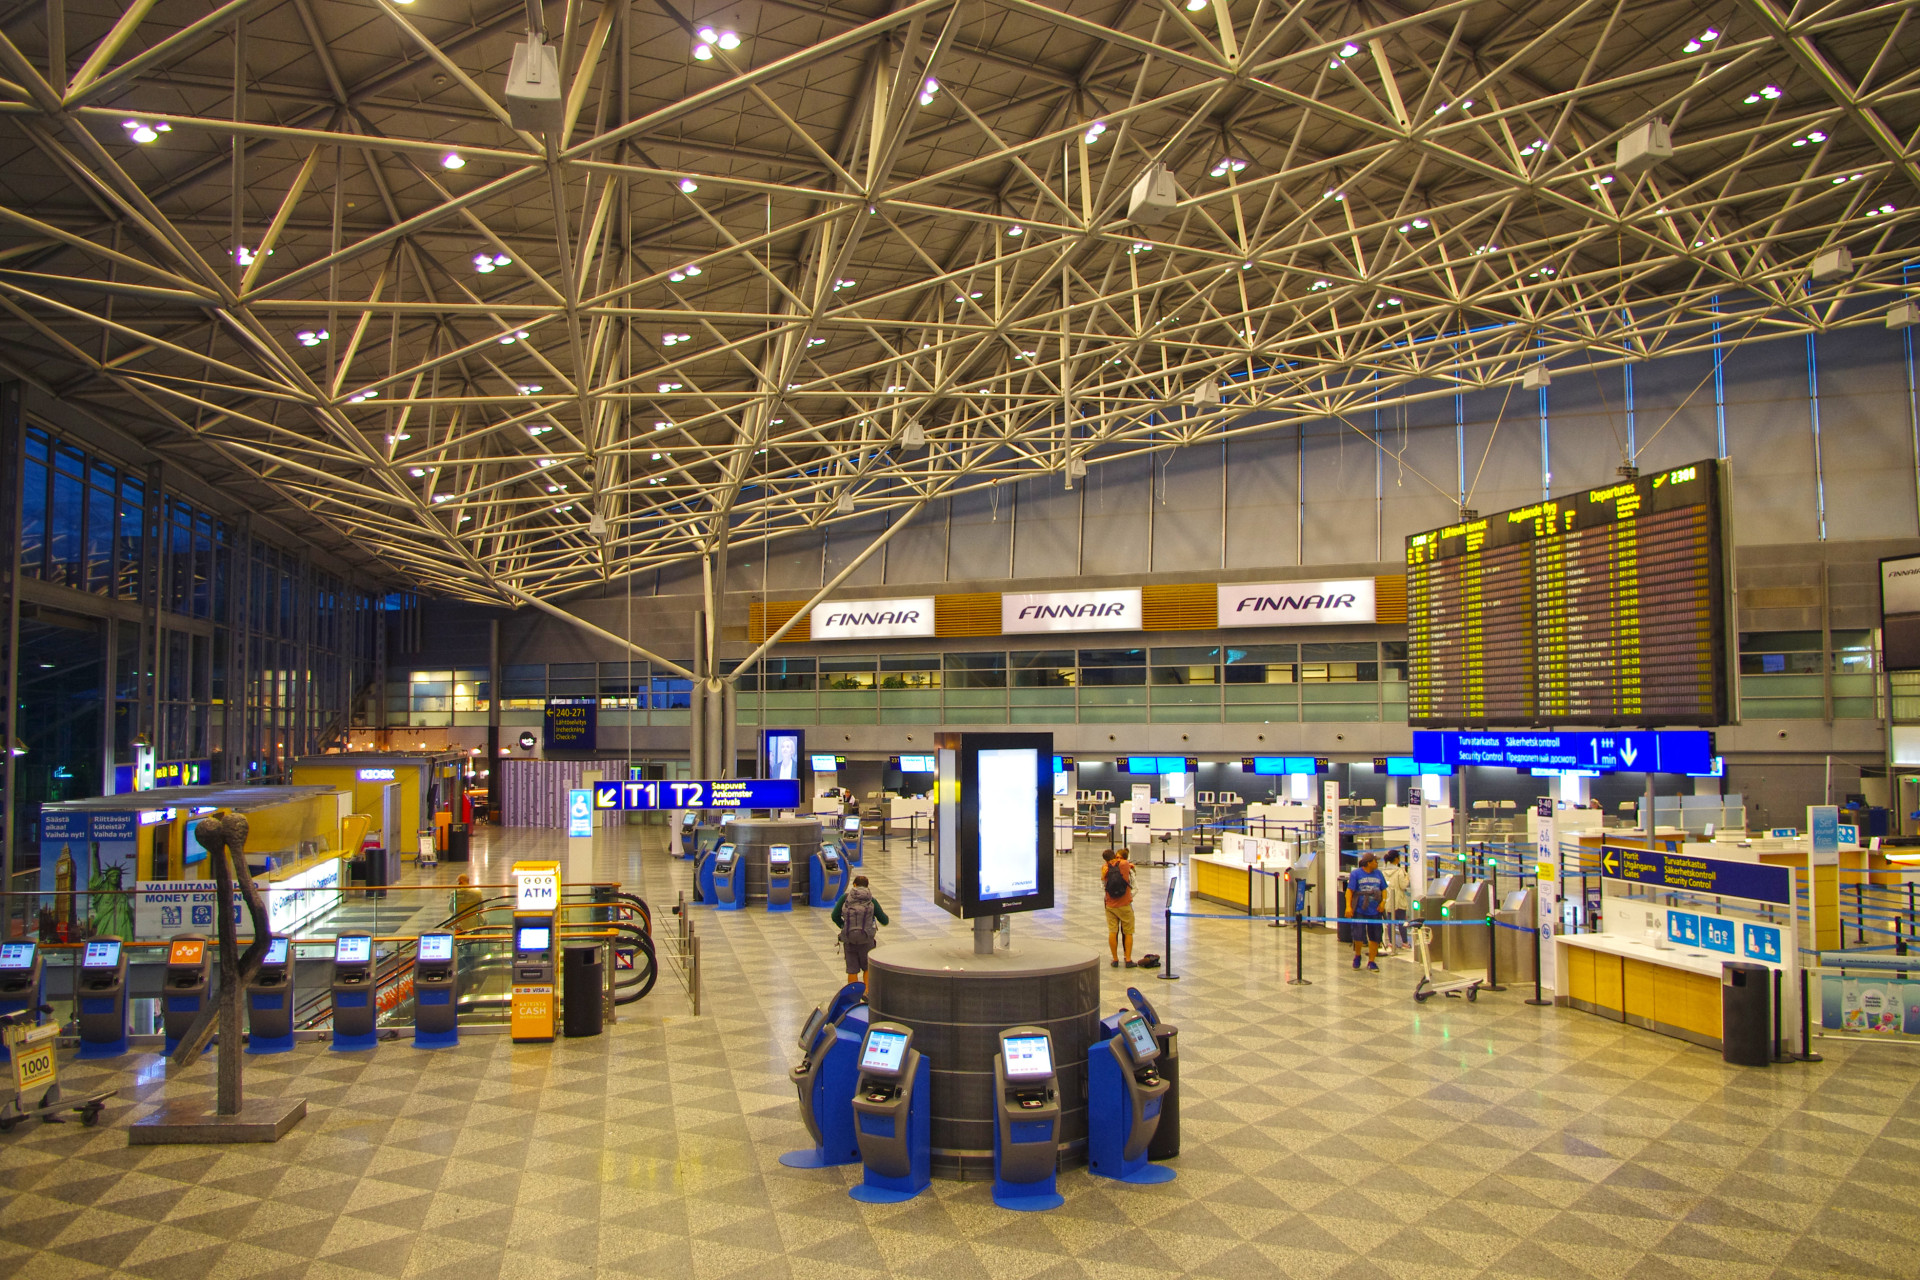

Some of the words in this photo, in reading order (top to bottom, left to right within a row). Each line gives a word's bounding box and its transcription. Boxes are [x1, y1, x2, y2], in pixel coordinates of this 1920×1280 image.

[1590, 484, 1635, 503] Departures
[1236, 594, 1356, 613] FINNAIR
[1019, 602, 1125, 620] FINNAIR
[826, 610, 920, 627] FINNAIR
[556, 708, 585, 718] 240-271
[1459, 736, 1500, 746] Turvatarkastus
[1506, 736, 1560, 748] Säkerhetskontroll
[1459, 751, 1481, 760] Security
[1482, 752, 1504, 761] Control
[1590, 738, 1598, 764] 1
[1602, 755, 1616, 765] min
[360, 768, 395, 780] KIOSK
[712, 782, 746, 790] Saapuvat
[626, 784, 656, 806] T1
[671, 784, 703, 806] T2
[712, 798, 740, 806] Arrivals
[1538, 799, 1552, 808] 9-40
[1820, 819, 1832, 828] Set
[1624, 851, 1638, 861] Portit
[1624, 861, 1656, 873] Utgångarna
[1664, 856, 1706, 869] Turvatarkastus
[1624, 870, 1640, 880] Gates
[1664, 866, 1716, 880] Säkerhetskontroll
[1664, 876, 1688, 888] Security
[1688, 878, 1712, 890] Control
[146, 894, 189, 903] MONEY
[524, 888, 552, 898] ATM
[520, 1007, 546, 1016] CASH
[22, 1056, 50, 1076] 1000
